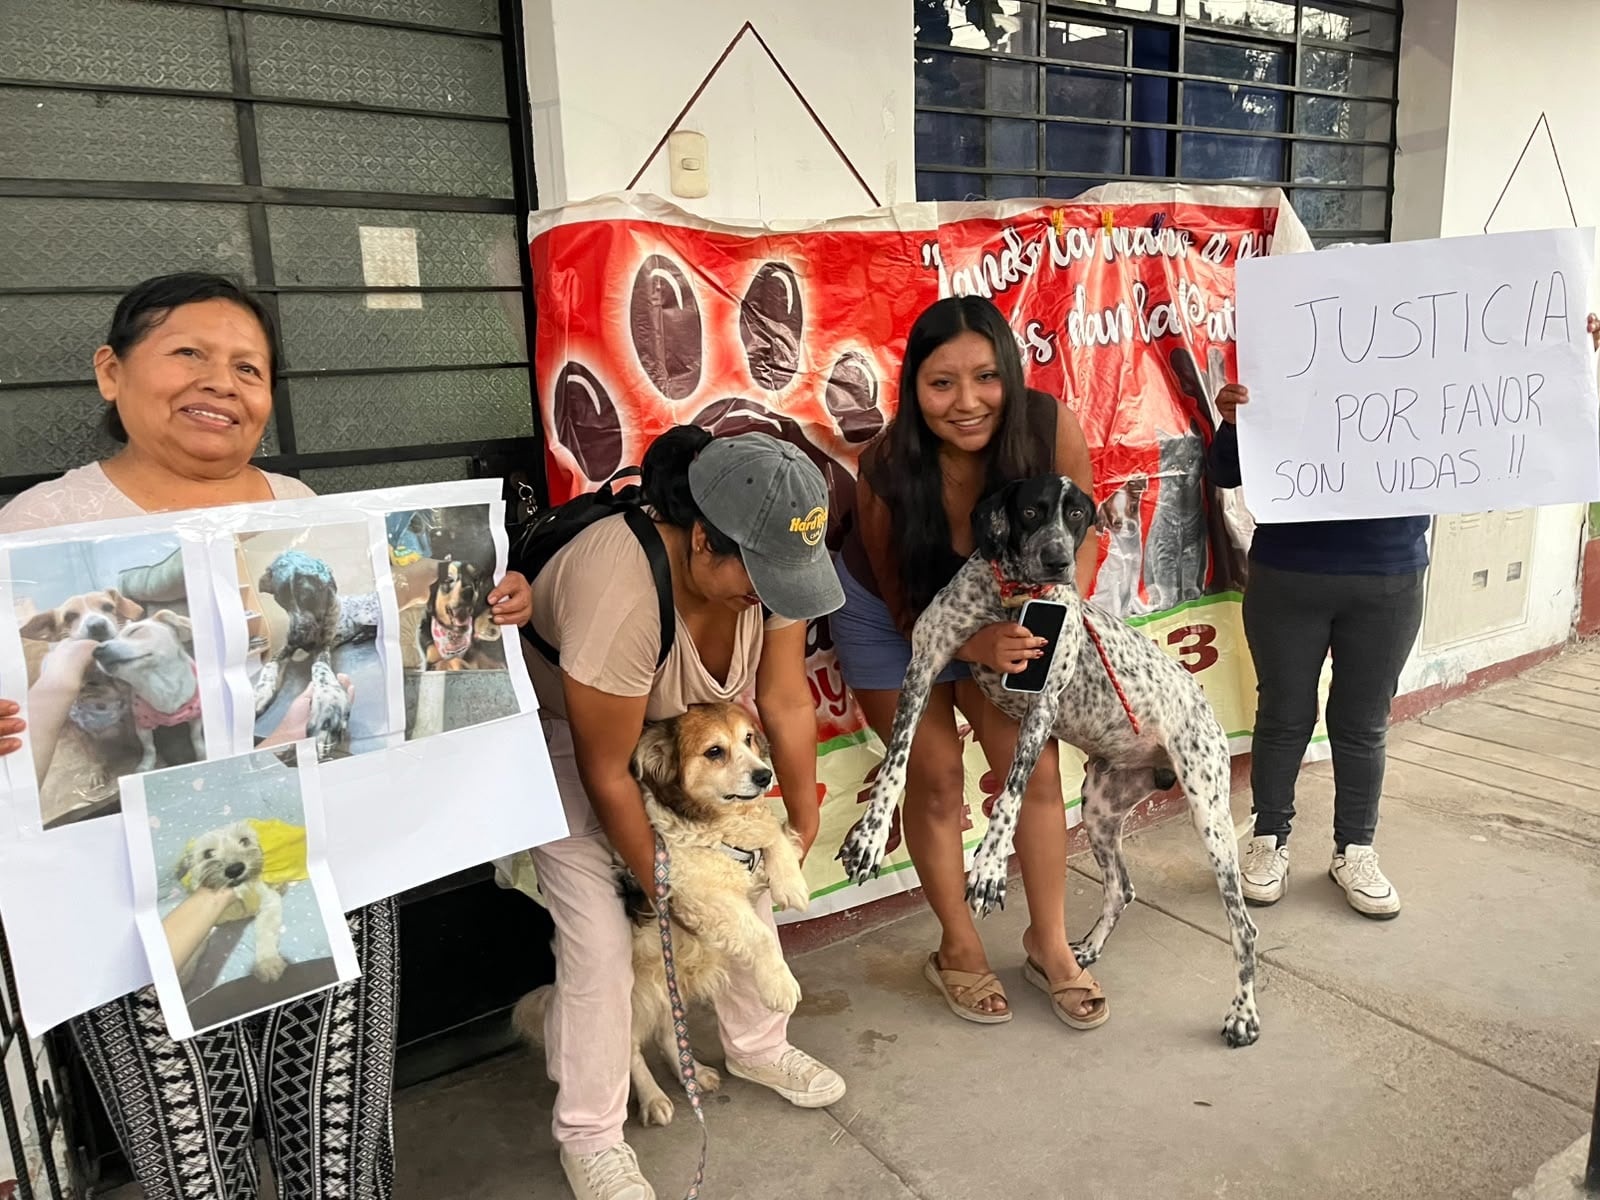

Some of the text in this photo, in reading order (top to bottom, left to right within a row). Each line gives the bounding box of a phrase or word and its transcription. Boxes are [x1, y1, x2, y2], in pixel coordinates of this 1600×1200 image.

[1047, 226, 1095, 267] la
[1101, 224, 1194, 261] mano
[1200, 231, 1230, 264] a
[1068, 283, 1134, 347] dan
[1133, 281, 1182, 344] la
[1178, 278, 1237, 345] Pat
[1286, 270, 1570, 378] JUSTICIA
[1335, 373, 1545, 452] POR FAVOR
[1271, 458, 1345, 502] SON
[788, 515, 816, 532] Hard
